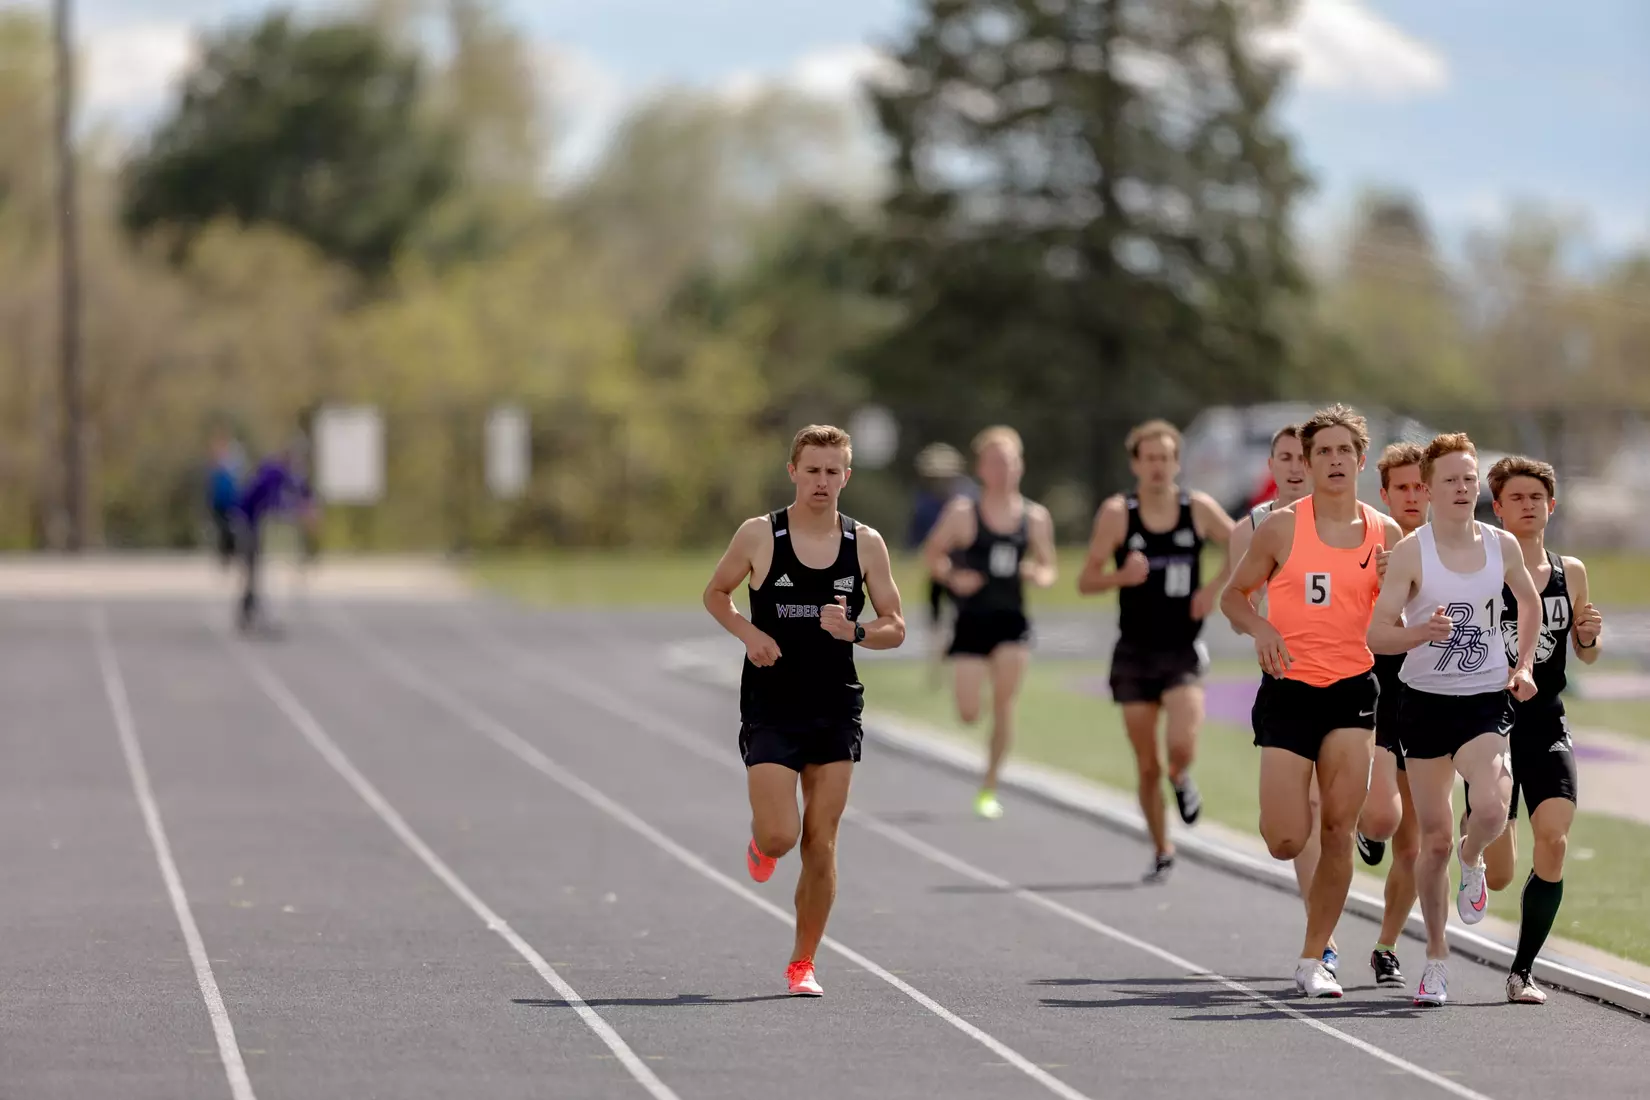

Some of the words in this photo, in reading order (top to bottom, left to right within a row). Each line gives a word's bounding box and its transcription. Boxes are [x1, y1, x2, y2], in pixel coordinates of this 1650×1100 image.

[1312, 575, 1326, 604] 5
[775, 603, 820, 618] WEBER
[1485, 598, 1494, 628] 1
[1551, 599, 1566, 628] 4
